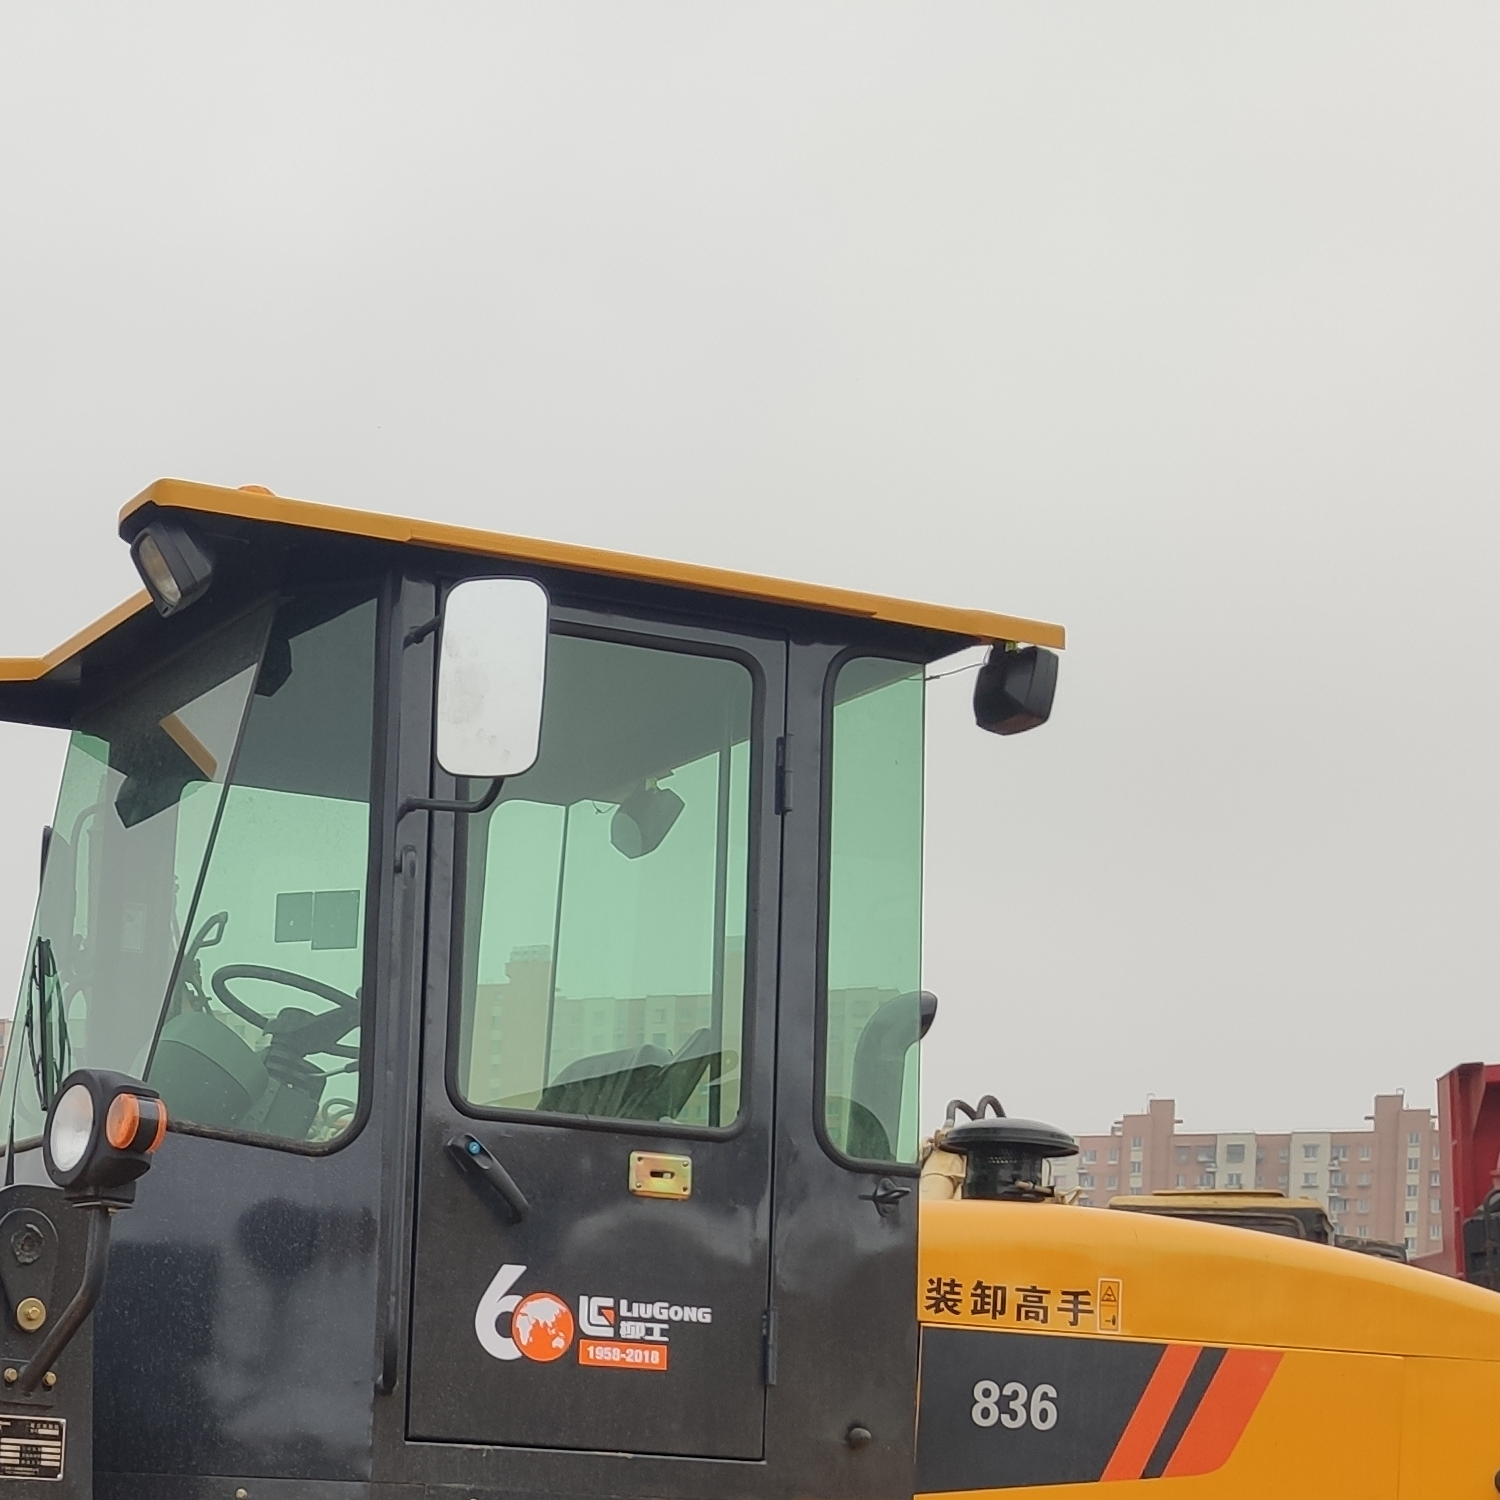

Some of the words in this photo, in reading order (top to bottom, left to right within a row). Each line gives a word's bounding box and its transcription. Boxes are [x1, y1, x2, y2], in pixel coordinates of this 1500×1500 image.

[924, 1277, 1095, 1327] 装卸高手
[587, 1345, 660, 1364] 1958-2018
[971, 1379, 1058, 1431] 836
